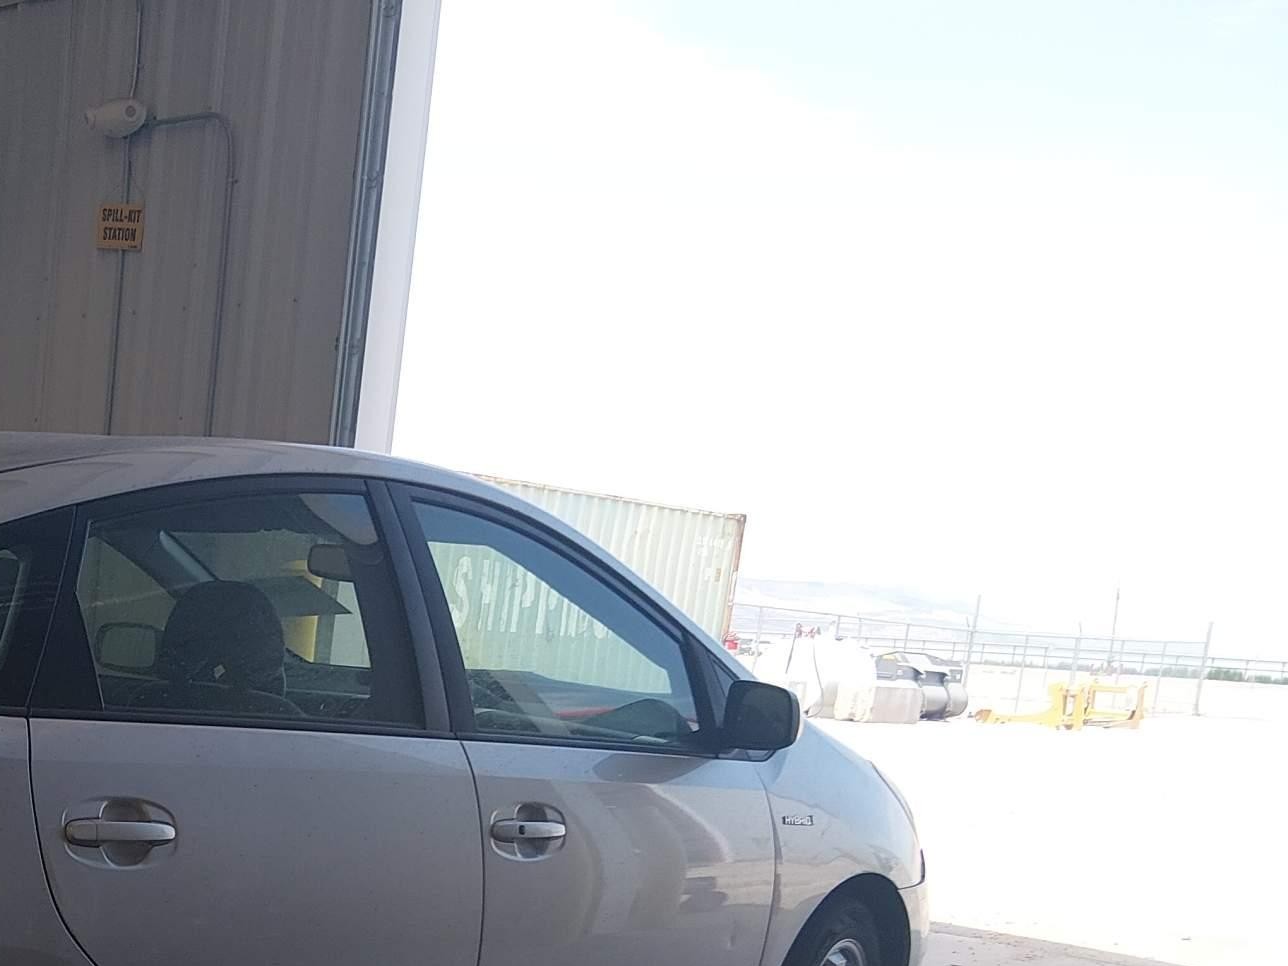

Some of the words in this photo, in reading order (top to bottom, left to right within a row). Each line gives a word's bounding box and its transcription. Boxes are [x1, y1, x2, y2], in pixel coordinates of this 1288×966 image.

[102, 208, 142, 223] SPILL-KIT
[103, 227, 137, 242] STATION
[783, 815, 813, 826] HYBRID
